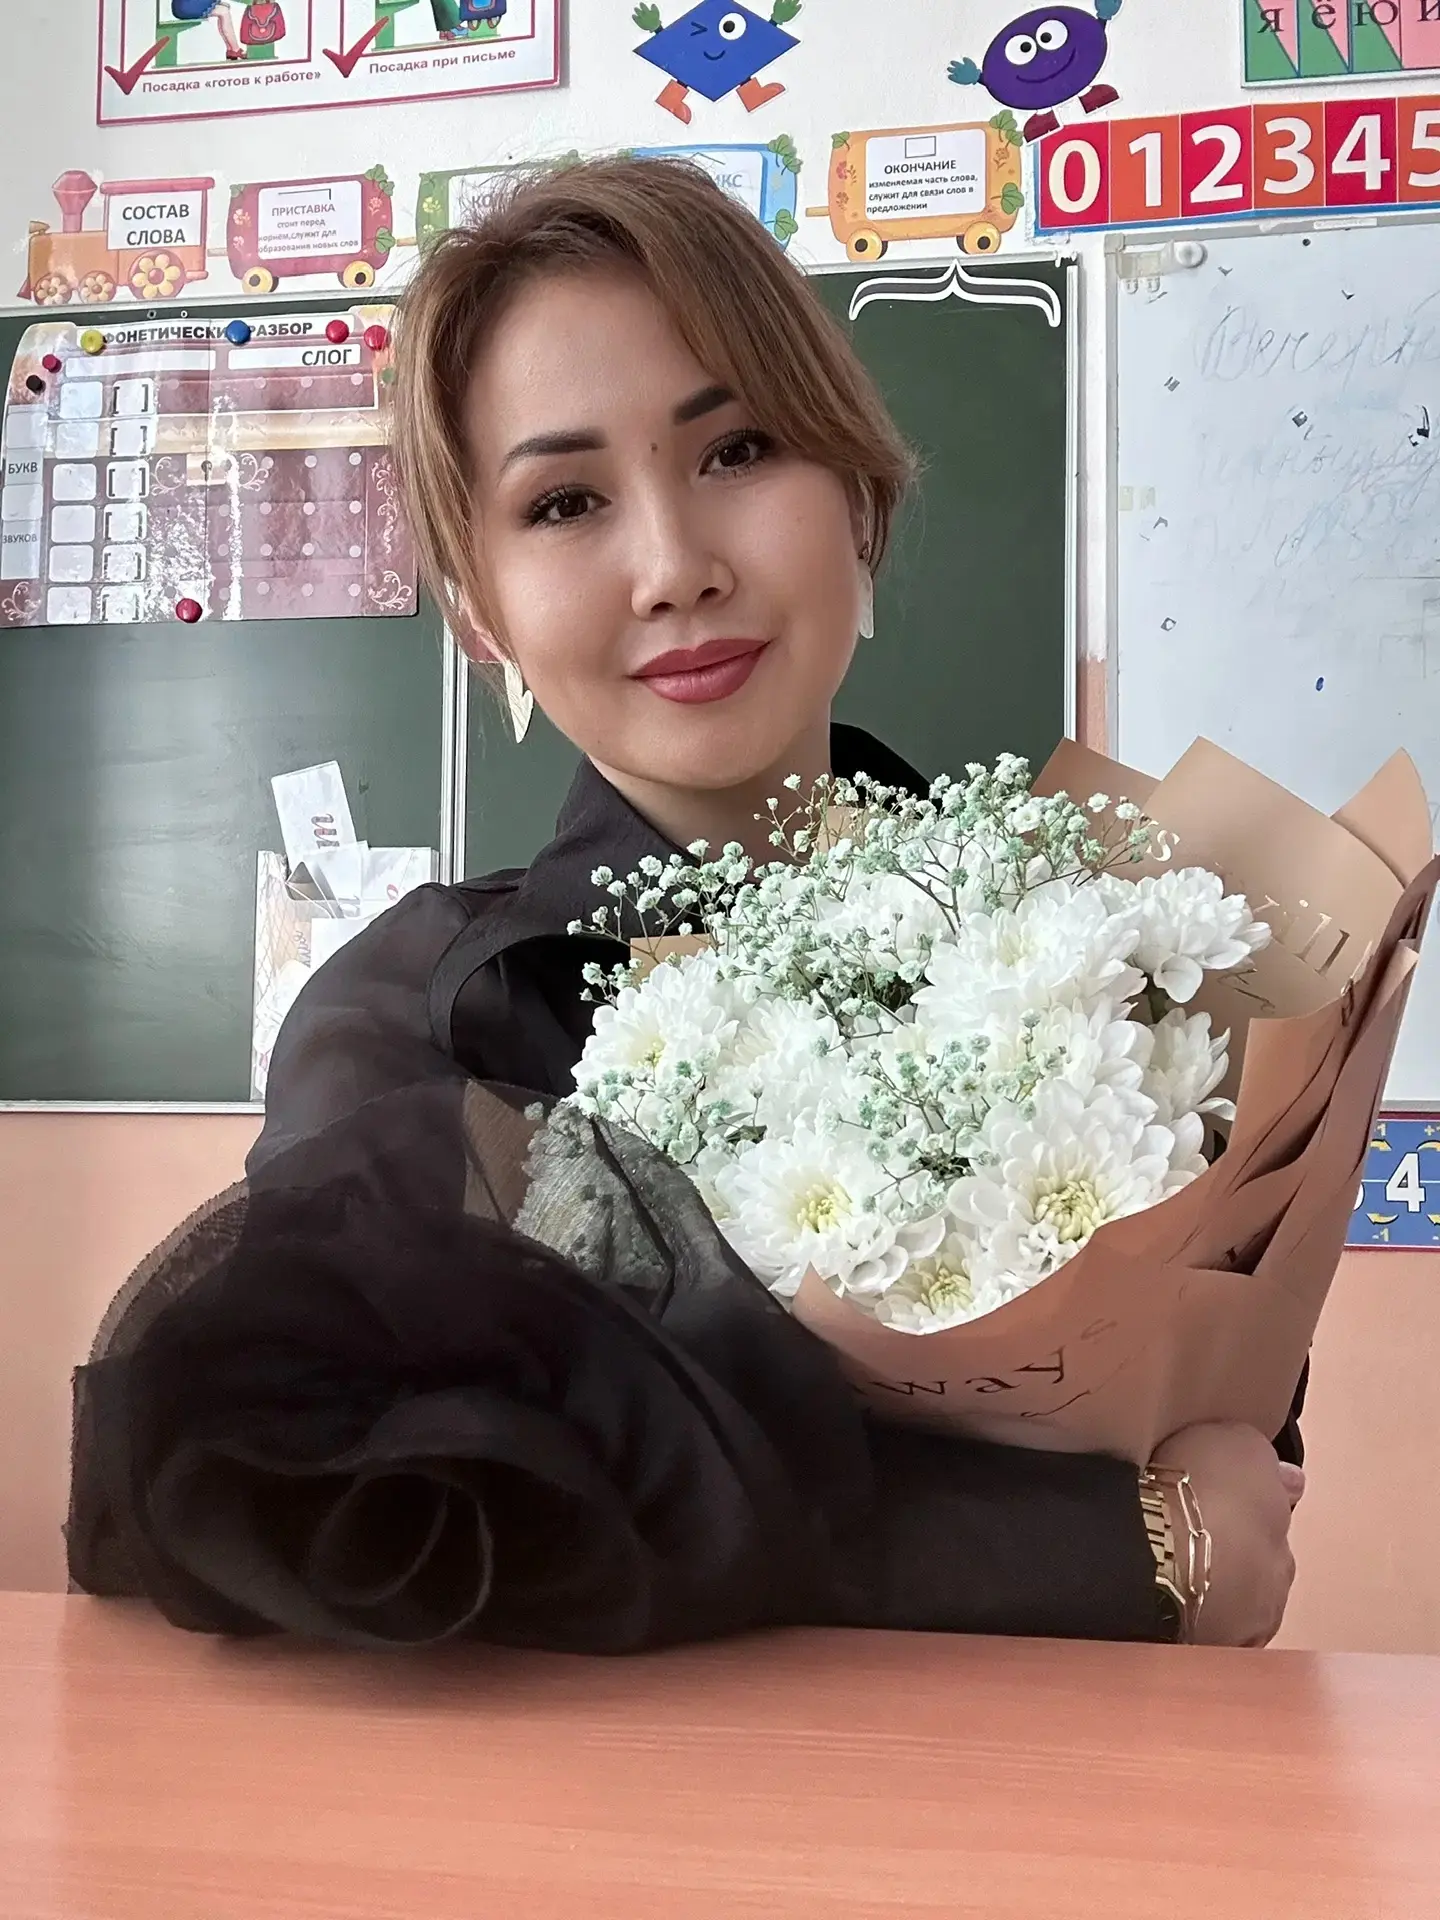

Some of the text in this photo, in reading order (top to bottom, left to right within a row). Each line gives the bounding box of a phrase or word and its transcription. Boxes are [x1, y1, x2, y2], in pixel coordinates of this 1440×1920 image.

[1256, 7, 1285, 34] я
[369, 49, 516, 75] Посадка при письме
[142, 70, 321, 93] Посадка «готов к работе»
[884, 159, 957, 175] ОКОНЧАНИЕ
[1048, 139, 1101, 214] 0
[1128, 131, 1162, 208] 1
[1189, 124, 1244, 204] 2
[1263, 116, 1315, 196] 3
[1331, 113, 1391, 191] 4
[868, 174, 978, 189] изменяемая часть слова,
[868, 185, 974, 202] служит для связи слов в
[122, 203, 190, 221] СОСТАВ
[271, 203, 336, 217] ПРИСТАВКА
[866, 201, 928, 214] предложении
[300, 218, 326, 228] перед
[126, 228, 186, 246] СЛОВА
[104, 322, 313, 345] ФОНЕТИЧЕСКИ РАЗБОР
[301, 349, 352, 366] СЛОГ
[8, 461, 38, 475] БУКВ
[2, 533, 38, 545] ЗВУКОВ
[1385, 1151, 1427, 1213] 4
